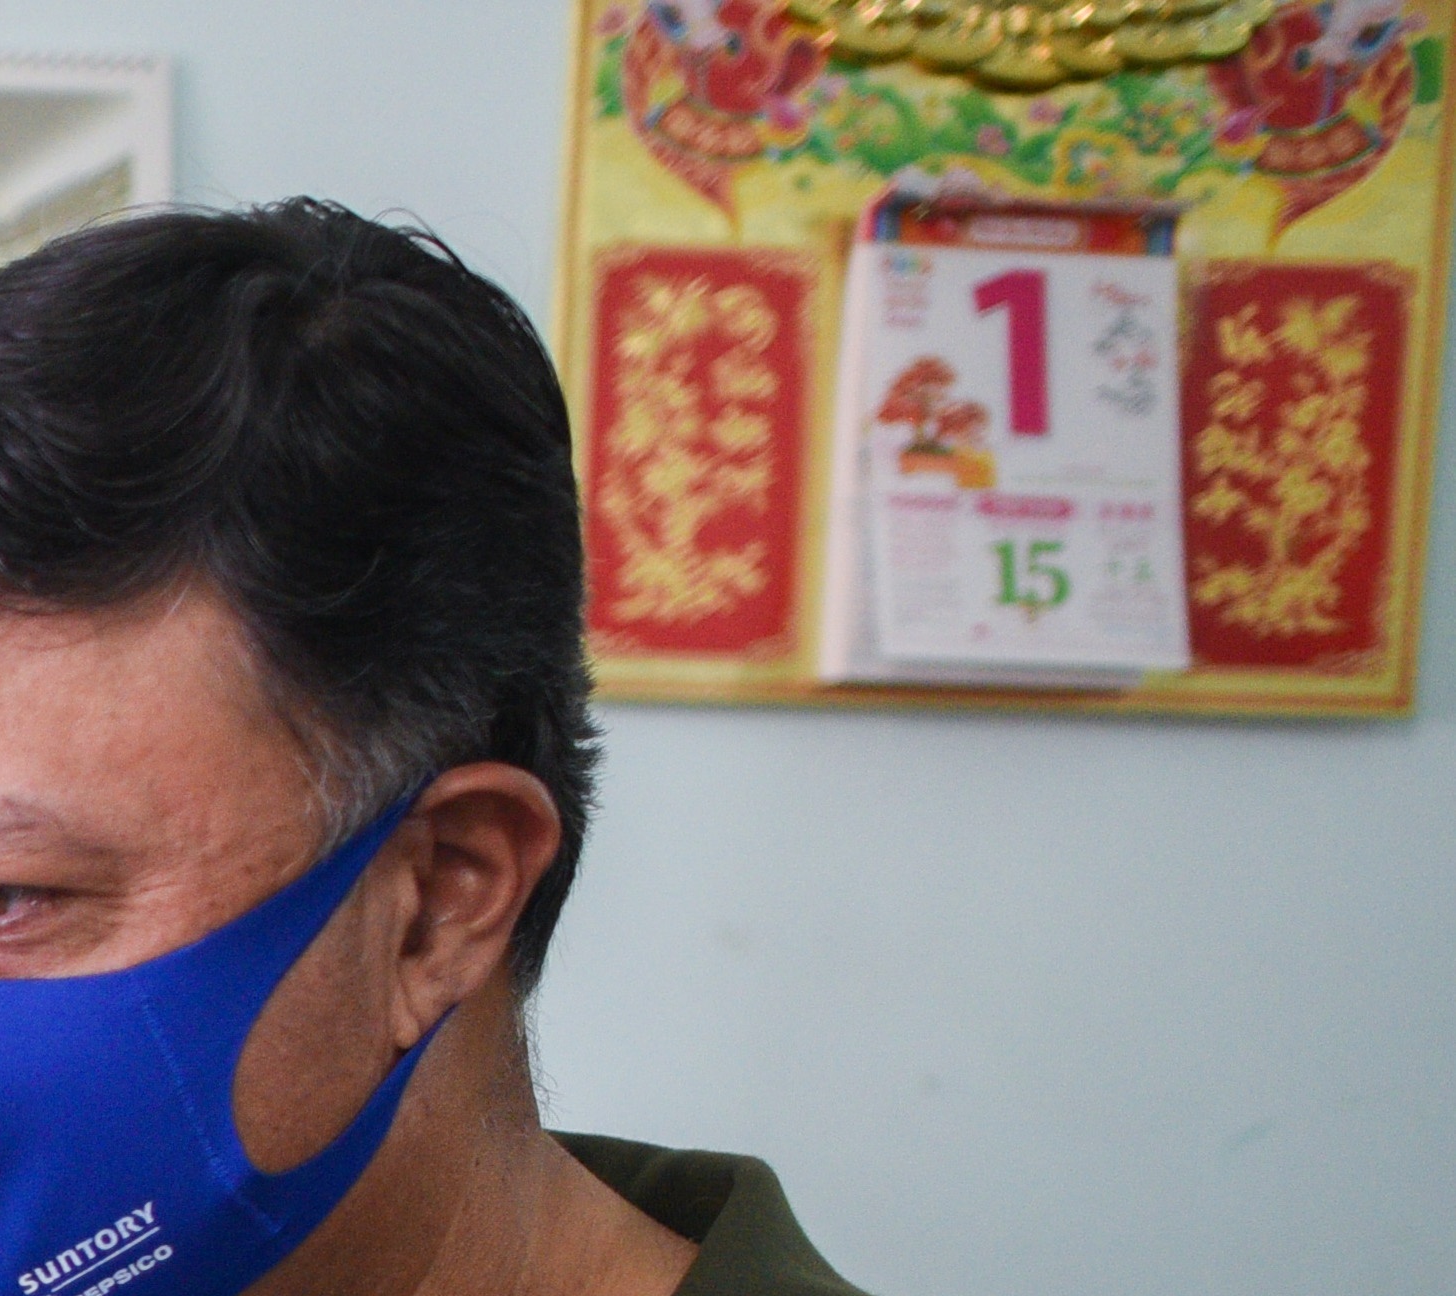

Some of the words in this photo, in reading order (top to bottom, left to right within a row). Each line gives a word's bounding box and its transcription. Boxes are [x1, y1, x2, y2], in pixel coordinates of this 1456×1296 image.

[972, 267, 1050, 438] 1
[990, 538, 1073, 609] 15
[17, 1200, 156, 1296] SUNTORY
